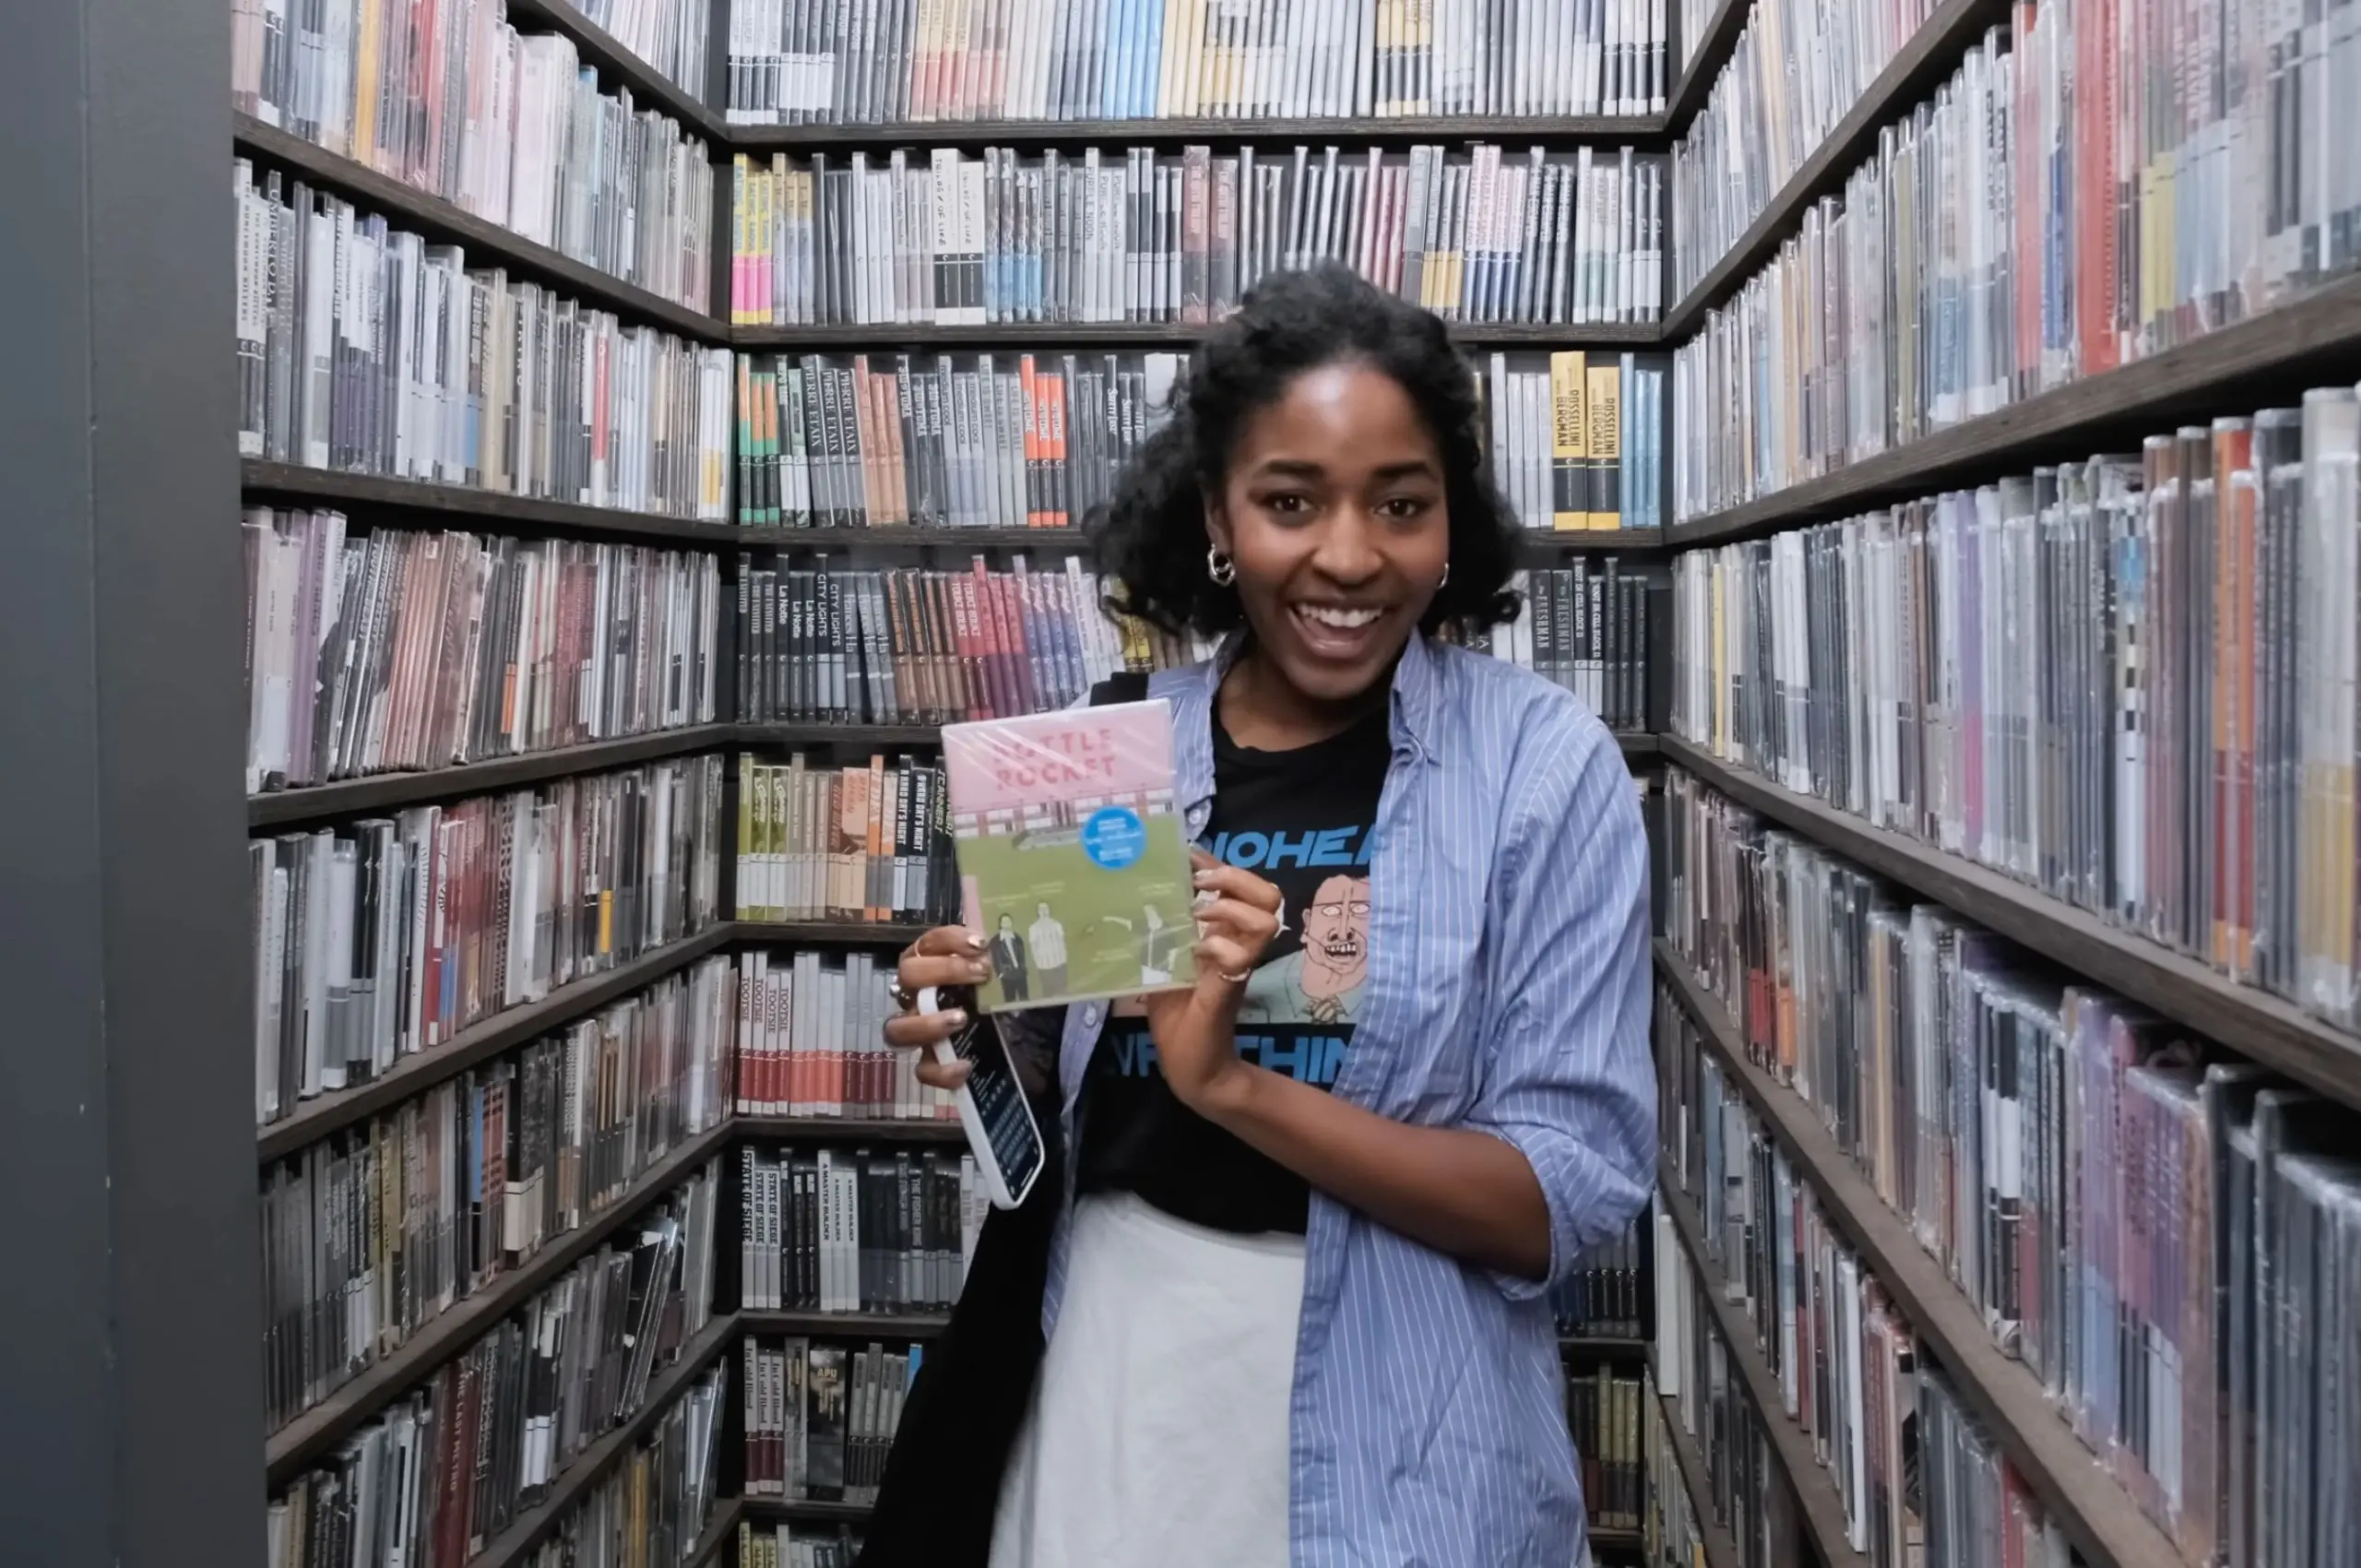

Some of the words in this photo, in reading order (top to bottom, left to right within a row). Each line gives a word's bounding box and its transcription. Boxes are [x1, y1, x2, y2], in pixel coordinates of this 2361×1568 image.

[268, 189, 279, 276] UMBERTO
[805, 365, 819, 408] PIERRE
[823, 372, 836, 413] PIERRE
[839, 372, 854, 413] PIERRE
[939, 364, 950, 403] medium
[942, 405, 952, 426] cool
[954, 383, 965, 422] medium
[1557, 397, 1568, 447] BERGMAN
[1569, 389, 1580, 447] ROSSELLINI
[1592, 404, 1603, 455] BERGMAN
[1604, 398, 1616, 455] ROSSELLINI
[957, 423, 967, 445] cool
[972, 423, 980, 445] cool
[779, 585, 789, 597] La
[817, 574, 827, 600] CITY
[830, 584, 839, 608] CITY
[779, 599, 789, 624] Notte
[792, 600, 801, 612] La
[805, 600, 814, 612] La
[1574, 593, 1584, 609] CELL
[792, 614, 801, 639] Notte
[805, 613, 814, 638] Notte
[818, 601, 827, 637] LIGHTS
[831, 611, 841, 647] LIGHTS
[1536, 596, 1549, 648] FRESHMAN
[1557, 598, 1570, 651] FRESHMAN
[1574, 610, 1584, 631] BLOCK
[1592, 613, 1601, 629] CELL
[845, 636, 858, 653] Ha
[863, 636, 875, 653] Ha
[877, 636, 889, 654] Ha
[1593, 630, 1602, 652] BLOCK
[898, 776, 909, 796] HARD
[916, 782, 926, 802] HARD
[897, 799, 908, 820] DAY'S
[915, 804, 926, 826] DAY'S
[935, 769, 945, 835] SCANNERS
[896, 821, 908, 845] NIGHT
[913, 826, 924, 851] NIGHT
[742, 977, 751, 1022] TOOTSIE
[754, 979, 764, 1023] TOOTSIE
[767, 989, 777, 1034] TOOTSIE
[780, 988, 789, 1032] TOOTSIE
[742, 1152, 753, 1184] STATE
[742, 1187, 753, 1204] OF
[755, 1172, 765, 1202] STATE
[768, 1173, 777, 1203] STATE
[911, 1179, 920, 1194] THE
[755, 1203, 765, 1215] OF
[769, 1204, 777, 1215] OF
[911, 1195, 921, 1225] FISHER
[742, 1208, 753, 1242] SIEGE
[755, 1217, 765, 1244] SIEGE
[769, 1218, 778, 1244] SIEGE
[912, 1227, 922, 1246] KING
[457, 1372, 468, 1399] THE
[455, 1402, 464, 1435] LAST
[450, 1442, 461, 1491] METRO
